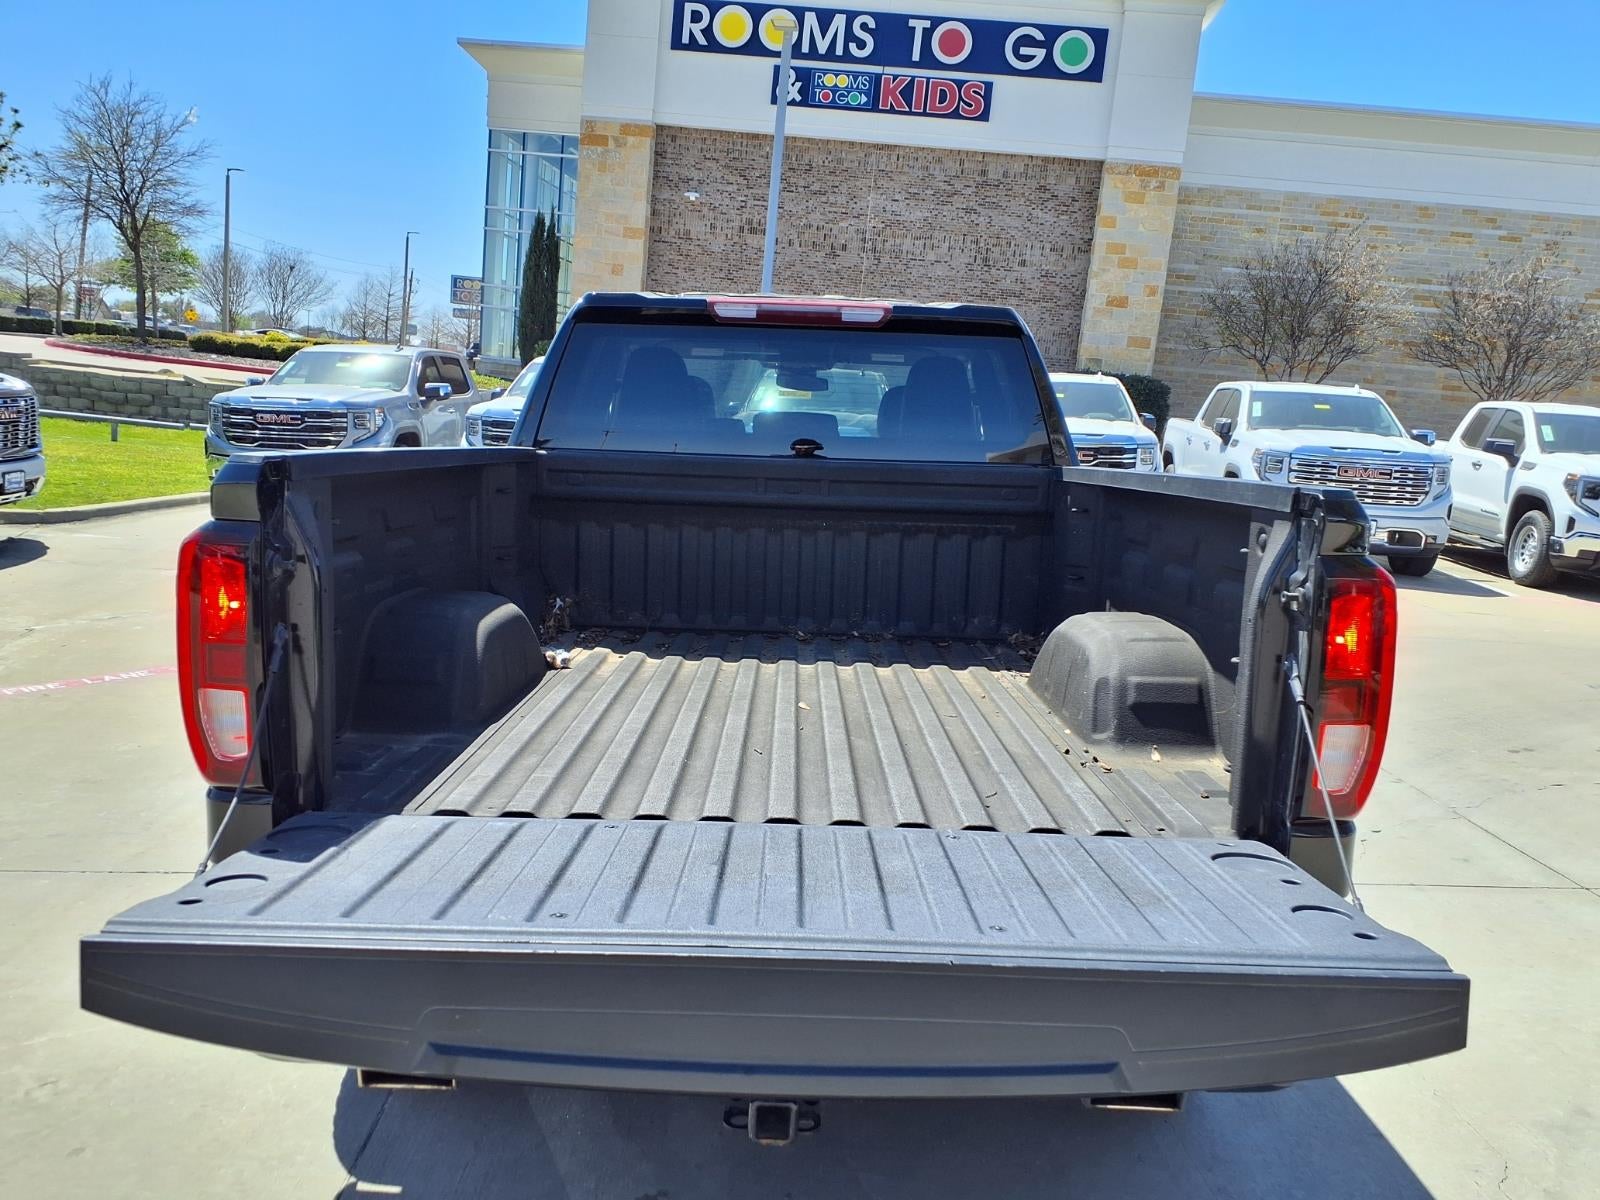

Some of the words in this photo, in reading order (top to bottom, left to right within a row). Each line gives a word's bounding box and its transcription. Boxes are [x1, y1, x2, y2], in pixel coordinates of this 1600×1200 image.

[681, 2, 877, 58] ROOMS
[908, 18, 973, 65] TO
[1004, 26, 1095, 74] GO
[814, 72, 870, 90] ROOMS
[814, 88, 833, 104] TO
[835, 90, 861, 105] GO
[878, 74, 985, 118] KIDS
[456, 278, 481, 290] ROO
[256, 413, 301, 424] GMC
[1339, 467, 1391, 479] GMC
[3, 682, 65, 696] FIRE
[82, 669, 152, 685] LANE
